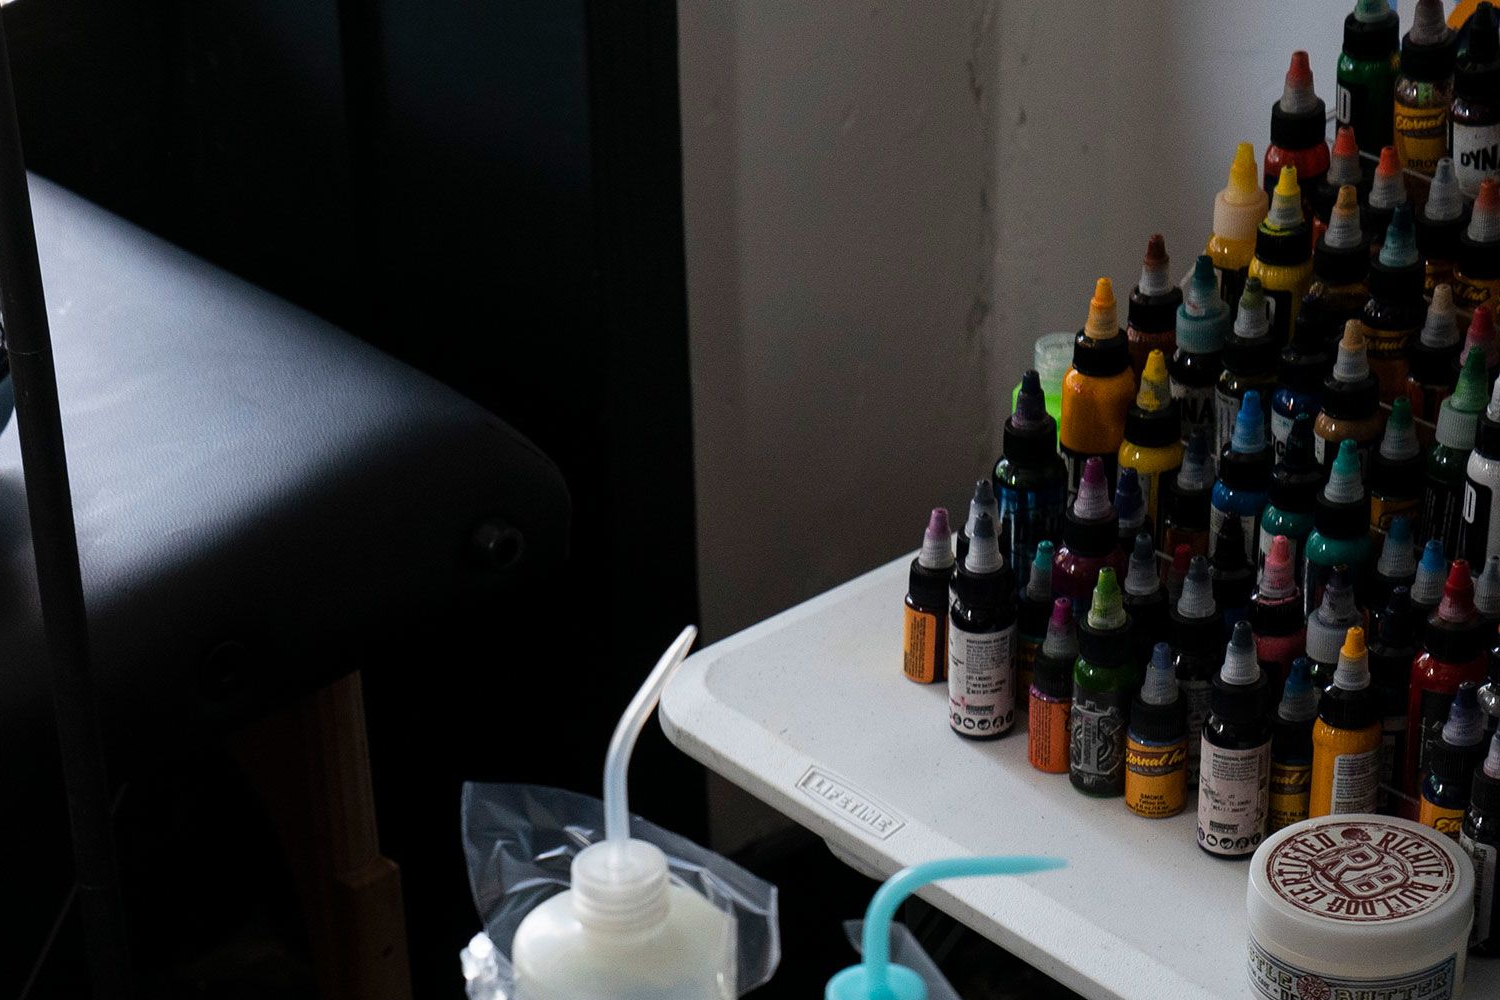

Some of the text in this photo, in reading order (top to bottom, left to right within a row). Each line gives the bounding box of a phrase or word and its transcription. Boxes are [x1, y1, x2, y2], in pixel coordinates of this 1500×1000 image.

[1277, 831, 1337, 905] CERTIFIED
[1376, 831, 1444, 878] RICHIE
[1325, 881, 1440, 917] BULLDOG
